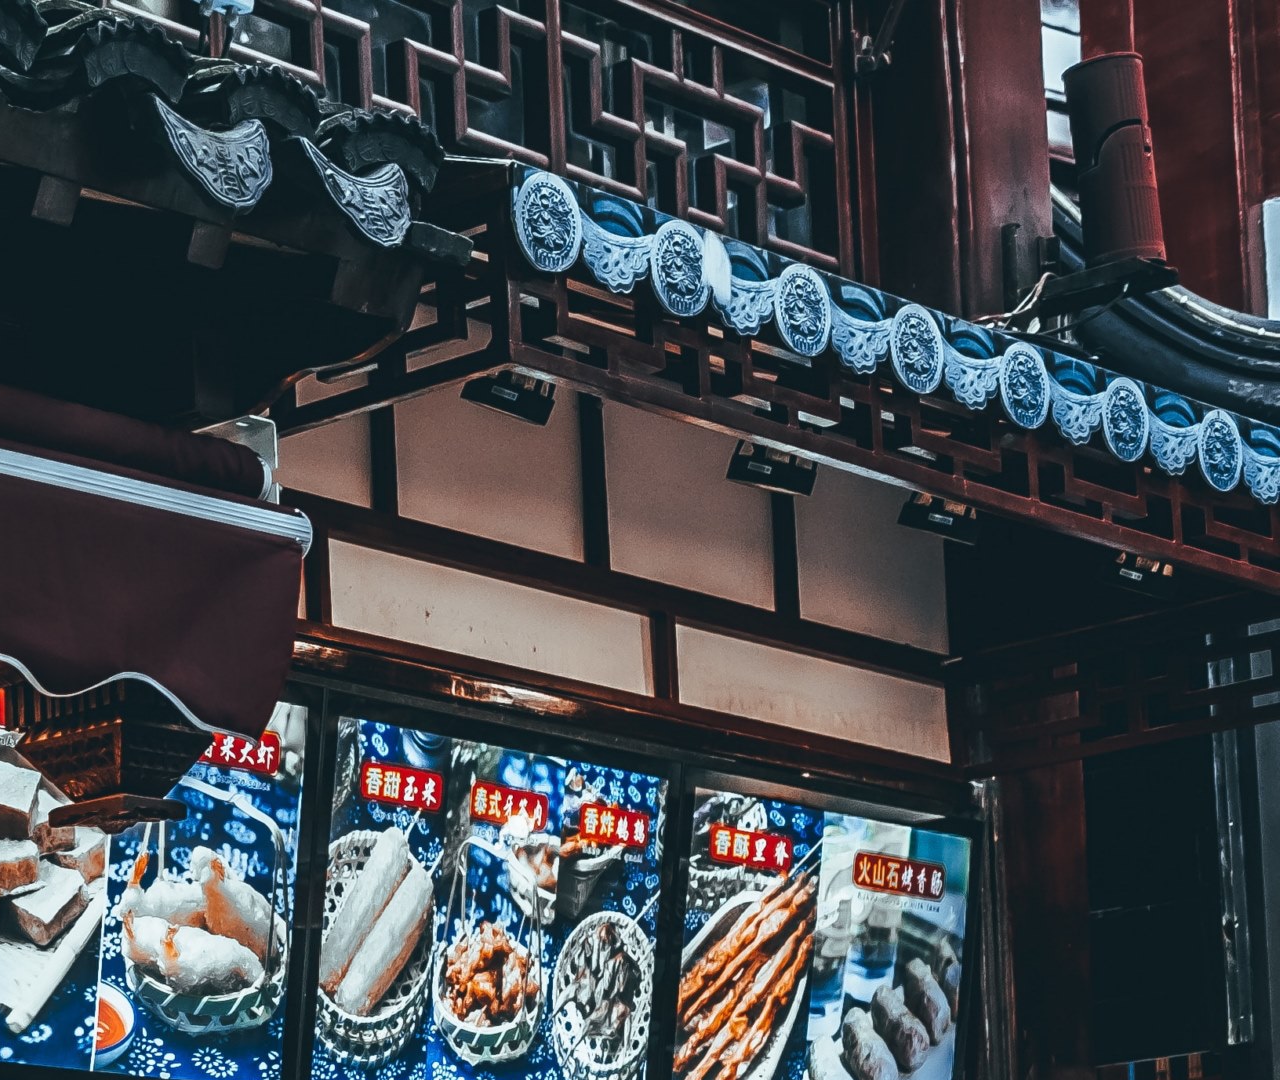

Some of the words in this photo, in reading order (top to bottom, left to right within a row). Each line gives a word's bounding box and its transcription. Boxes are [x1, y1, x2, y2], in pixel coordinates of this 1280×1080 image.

[365, 767, 437, 806] 香甜玉米
[857, 856, 943, 897] 火山石烤香肠
